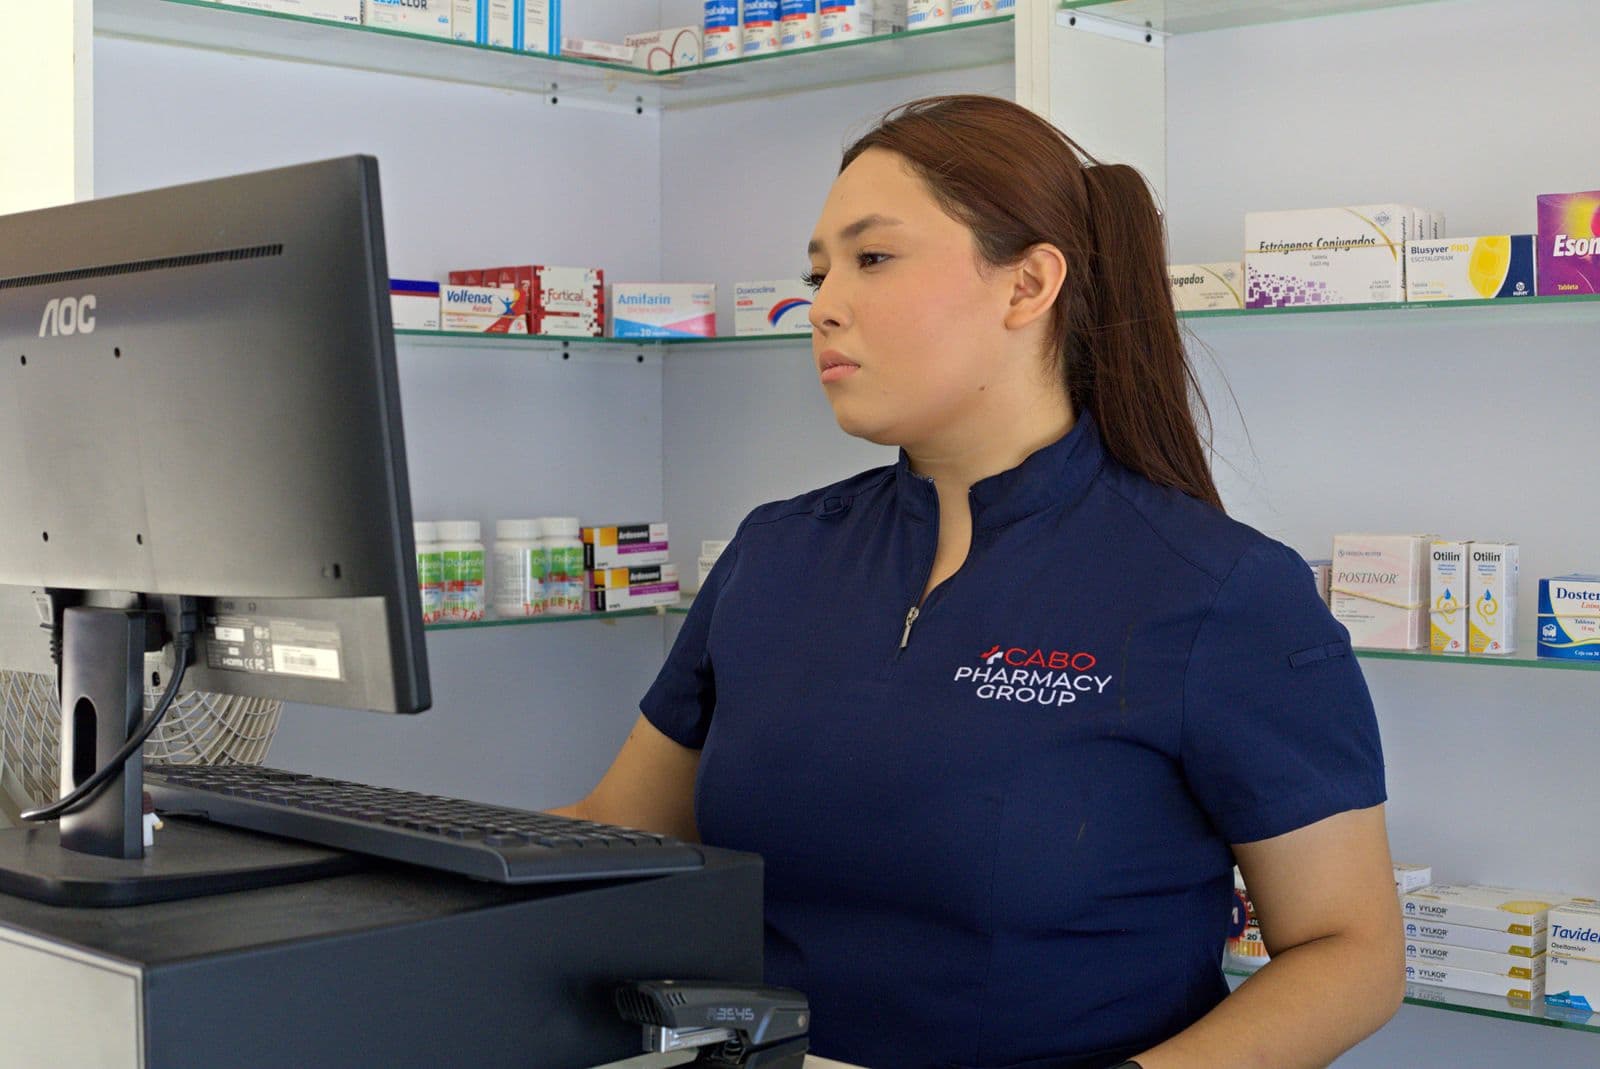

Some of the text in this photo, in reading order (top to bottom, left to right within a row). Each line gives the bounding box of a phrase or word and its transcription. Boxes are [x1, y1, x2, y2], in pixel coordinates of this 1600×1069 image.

[1316, 234, 1377, 252] Conjugados
[1410, 243, 1469, 256] Blusyver PRO
[1170, 273, 1205, 287] jugados
[447, 289, 494, 304] Volfenac
[545, 288, 585, 305] Fortical
[618, 293, 672, 305] Amifarin
[38, 294, 97, 337] AOC
[1433, 551, 1461, 561] Otilin
[1473, 552, 1501, 562] Otilin
[1337, 571, 1397, 584] POSTINOR
[1005, 648, 1097, 671] CABO
[953, 666, 1113, 694] PHARMACY
[976, 684, 1077, 707] GROUP
[1418, 904, 1446, 915] VYLKOR
[1247, 932, 1258, 941] 20
[1420, 926, 1447, 937] VYLKOR
[1420, 947, 1448, 958] VYLKOR
[1551, 956, 1559, 964] 75
[1418, 969, 1446, 979] VYLKOR
